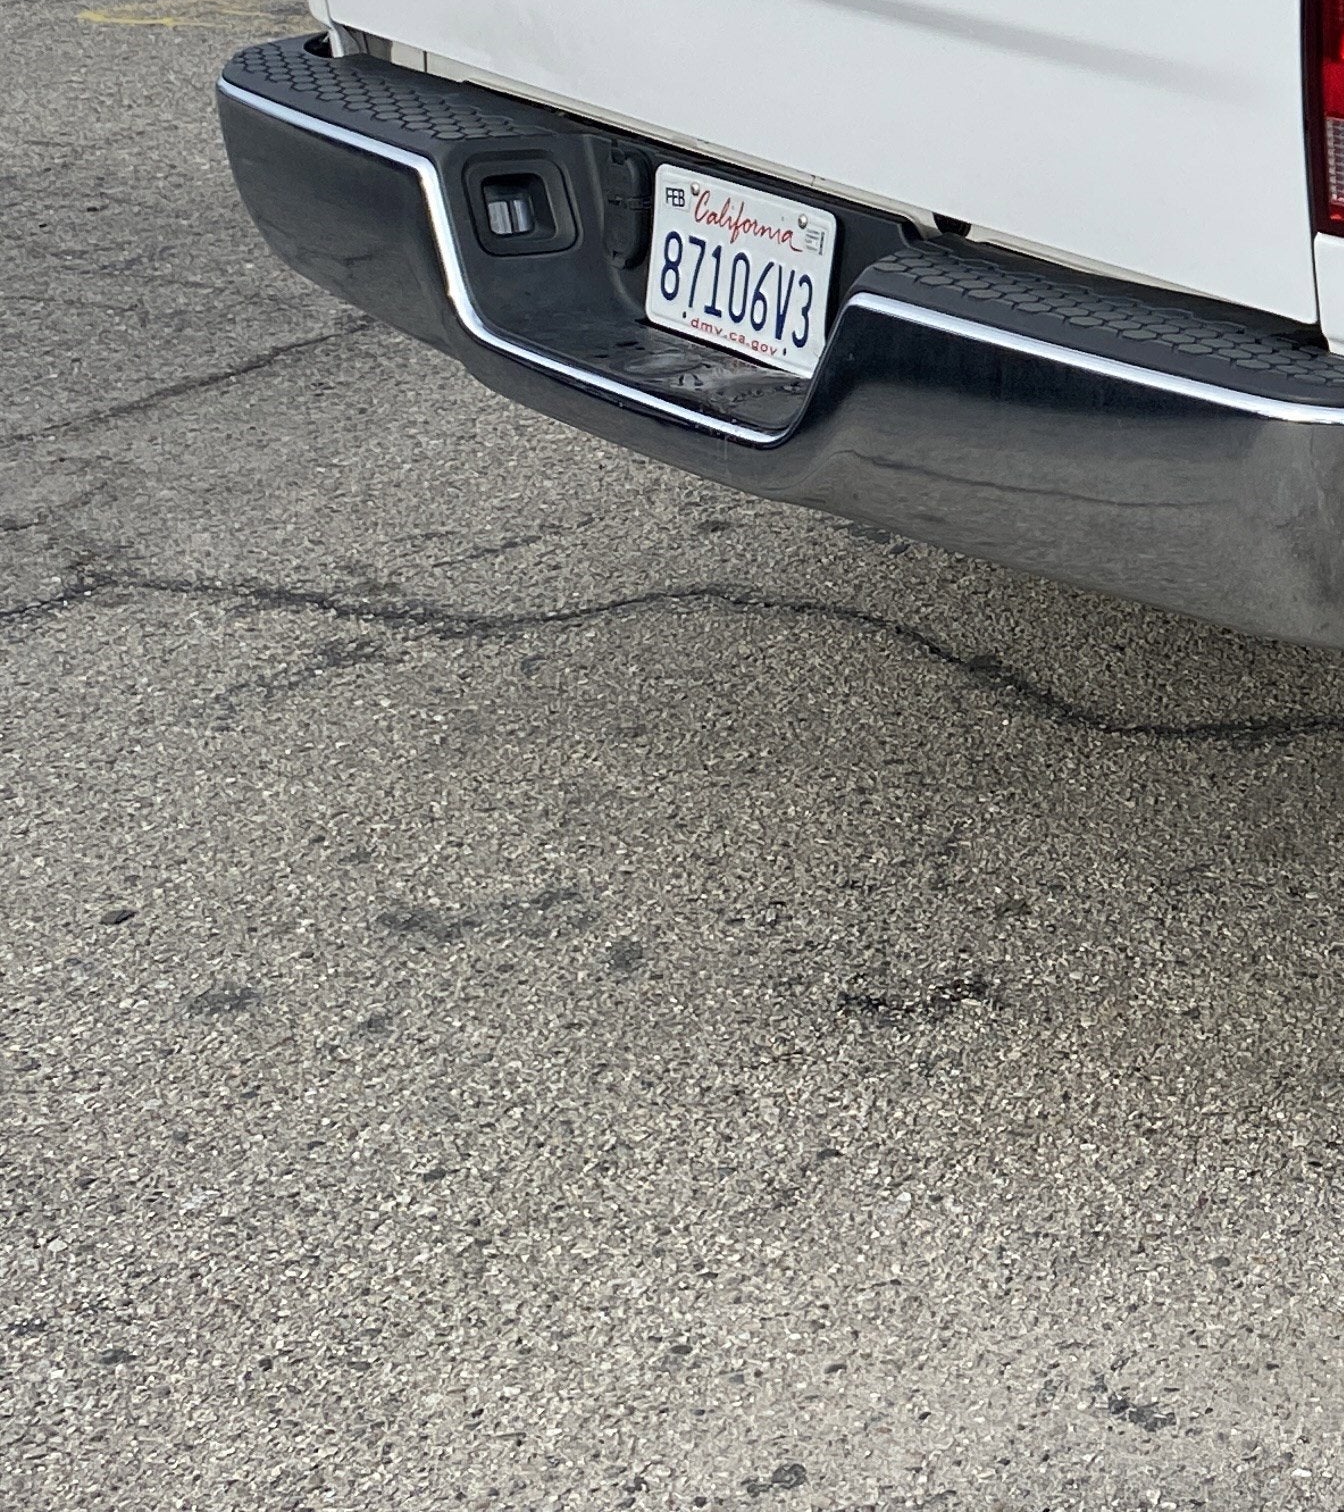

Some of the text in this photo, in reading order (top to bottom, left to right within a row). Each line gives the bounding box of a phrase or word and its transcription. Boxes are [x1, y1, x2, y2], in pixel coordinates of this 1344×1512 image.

[665, 186, 686, 208] FEB
[694, 190, 804, 253] California
[660, 230, 814, 349] 87106V3
[690, 317, 778, 357] dmv.ca.gov
